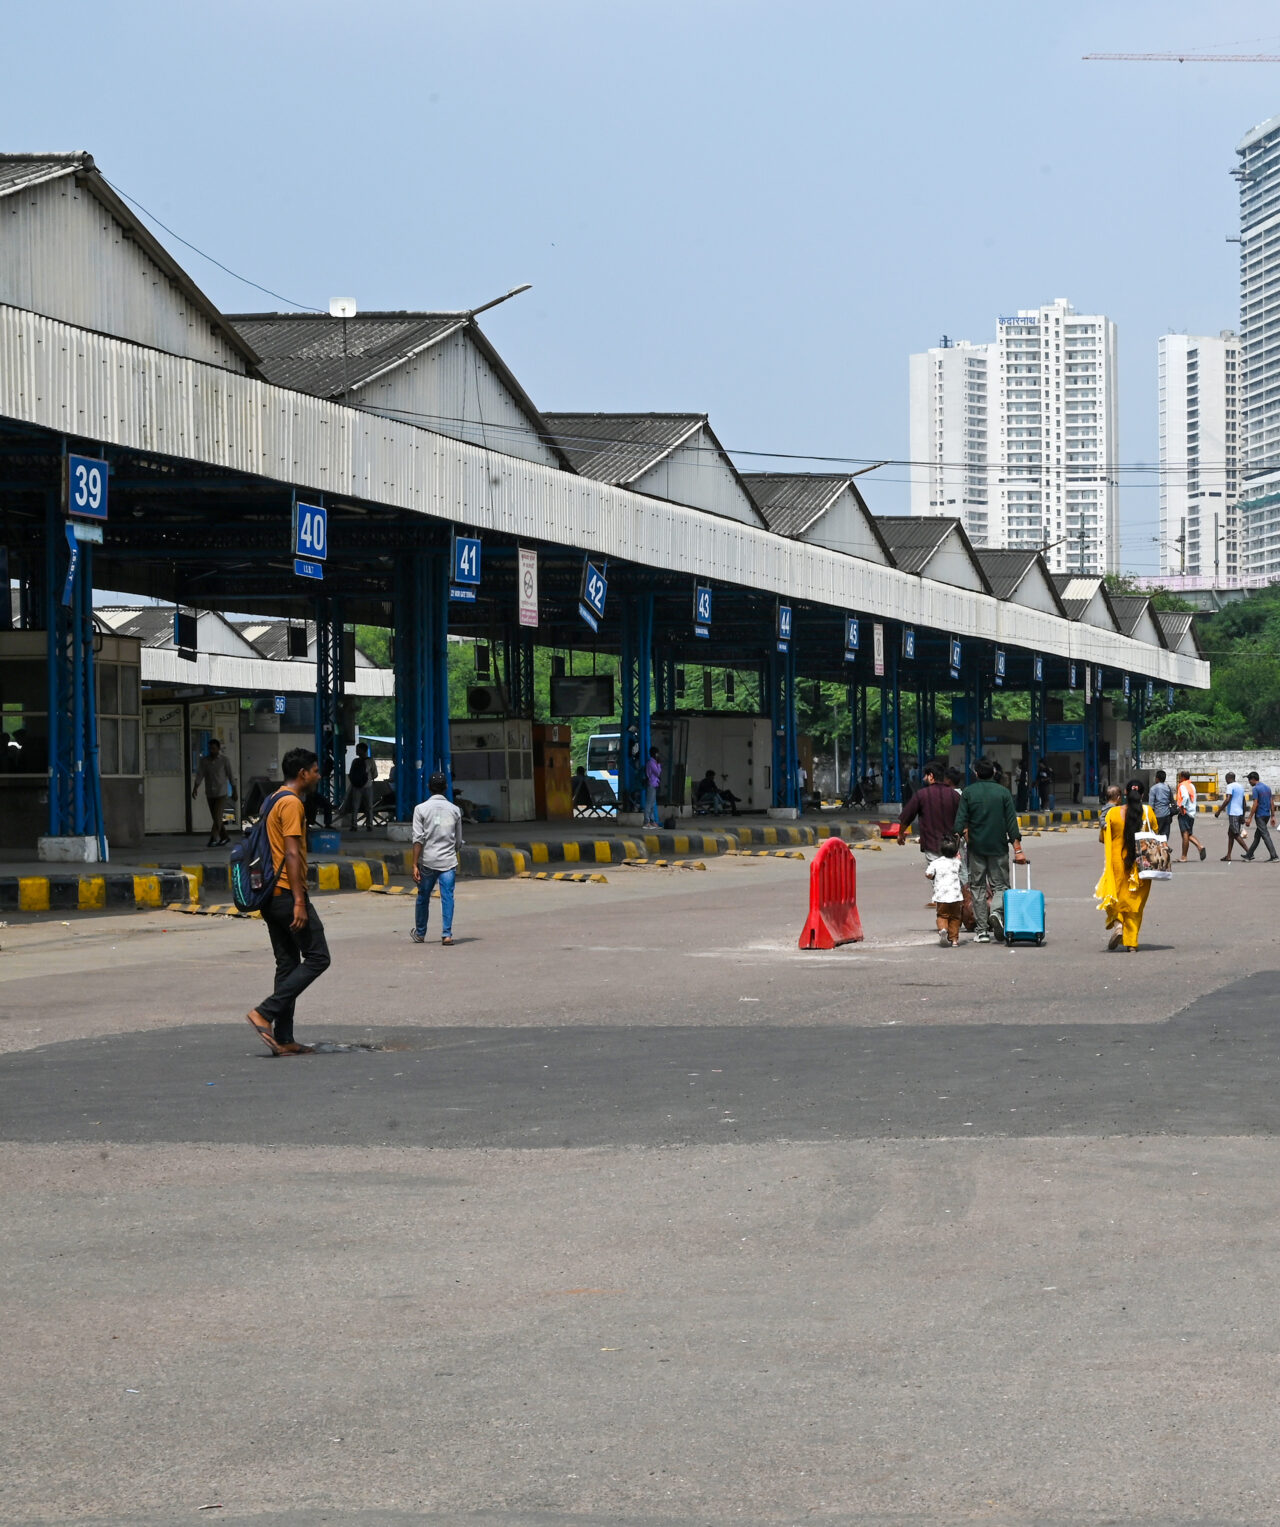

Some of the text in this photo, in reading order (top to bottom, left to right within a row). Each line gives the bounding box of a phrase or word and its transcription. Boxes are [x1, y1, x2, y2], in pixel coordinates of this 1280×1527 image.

[75, 465, 102, 509] 39
[301, 512, 324, 551] 40
[460, 545, 476, 576] 41
[589, 574, 604, 609] 42
[699, 593, 709, 618] 43
[781, 612, 790, 634] 44
[850, 623, 858, 645] 45
[906, 637, 914, 656] 46
[953, 646, 960, 665] 47
[276, 698, 285, 712] 96
